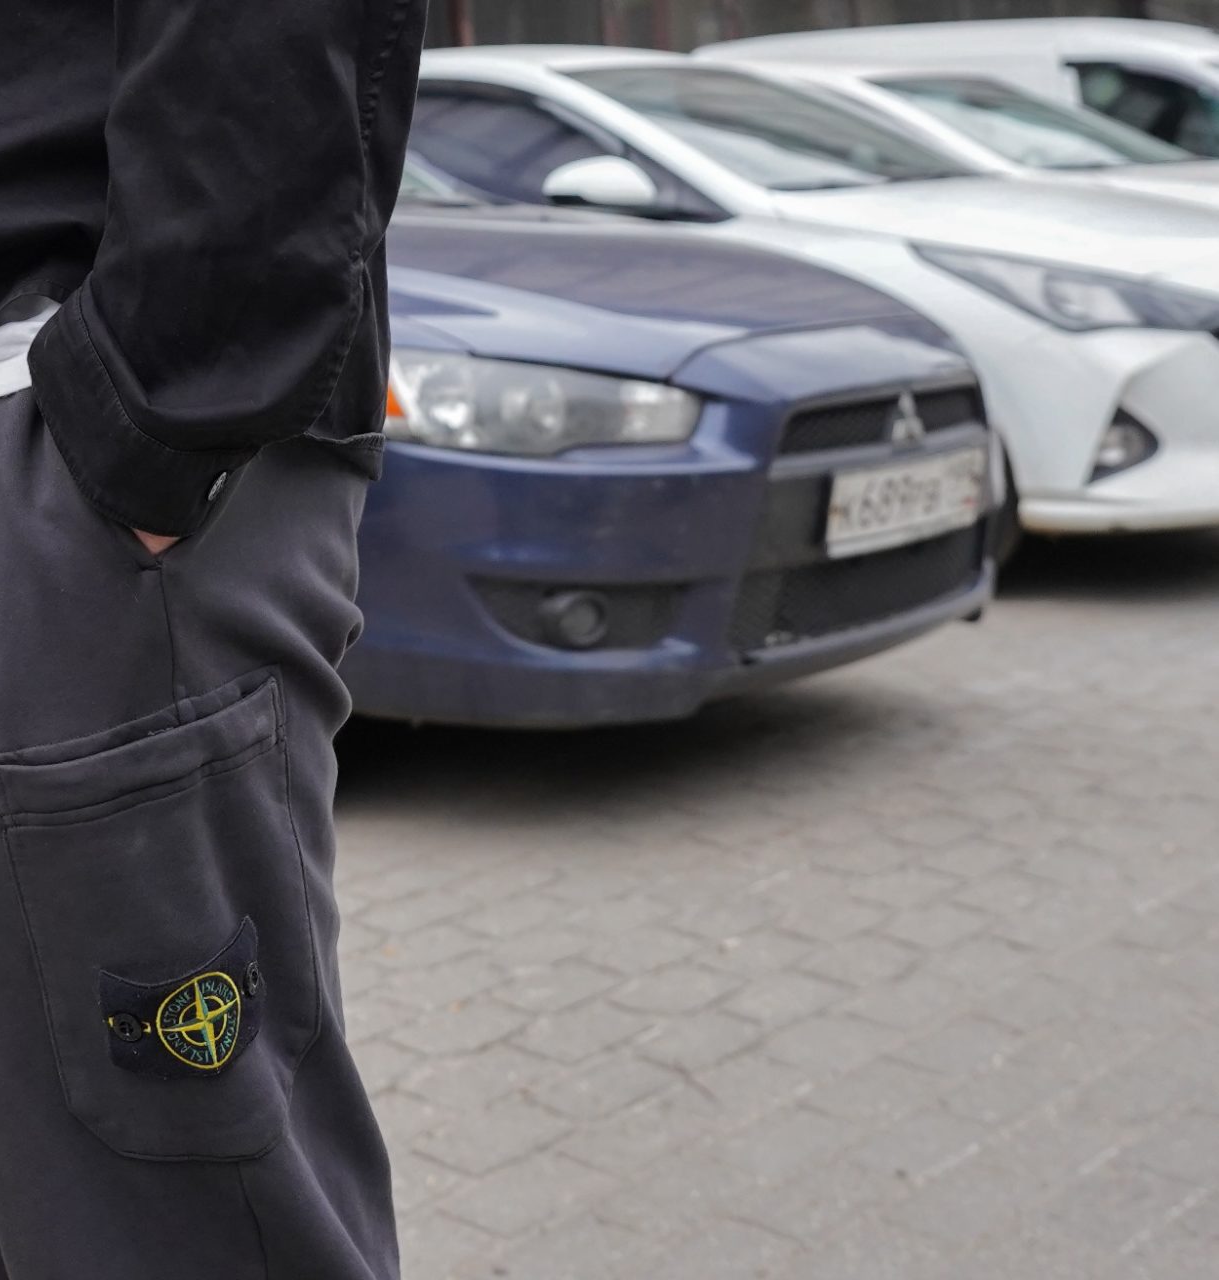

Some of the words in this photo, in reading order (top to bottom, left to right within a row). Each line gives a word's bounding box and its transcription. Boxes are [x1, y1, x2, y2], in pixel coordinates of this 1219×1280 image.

[163, 991, 191, 1023] STONE
[201, 980, 234, 1004] ISLAND
[167, 1033, 209, 1062] ISLAND
